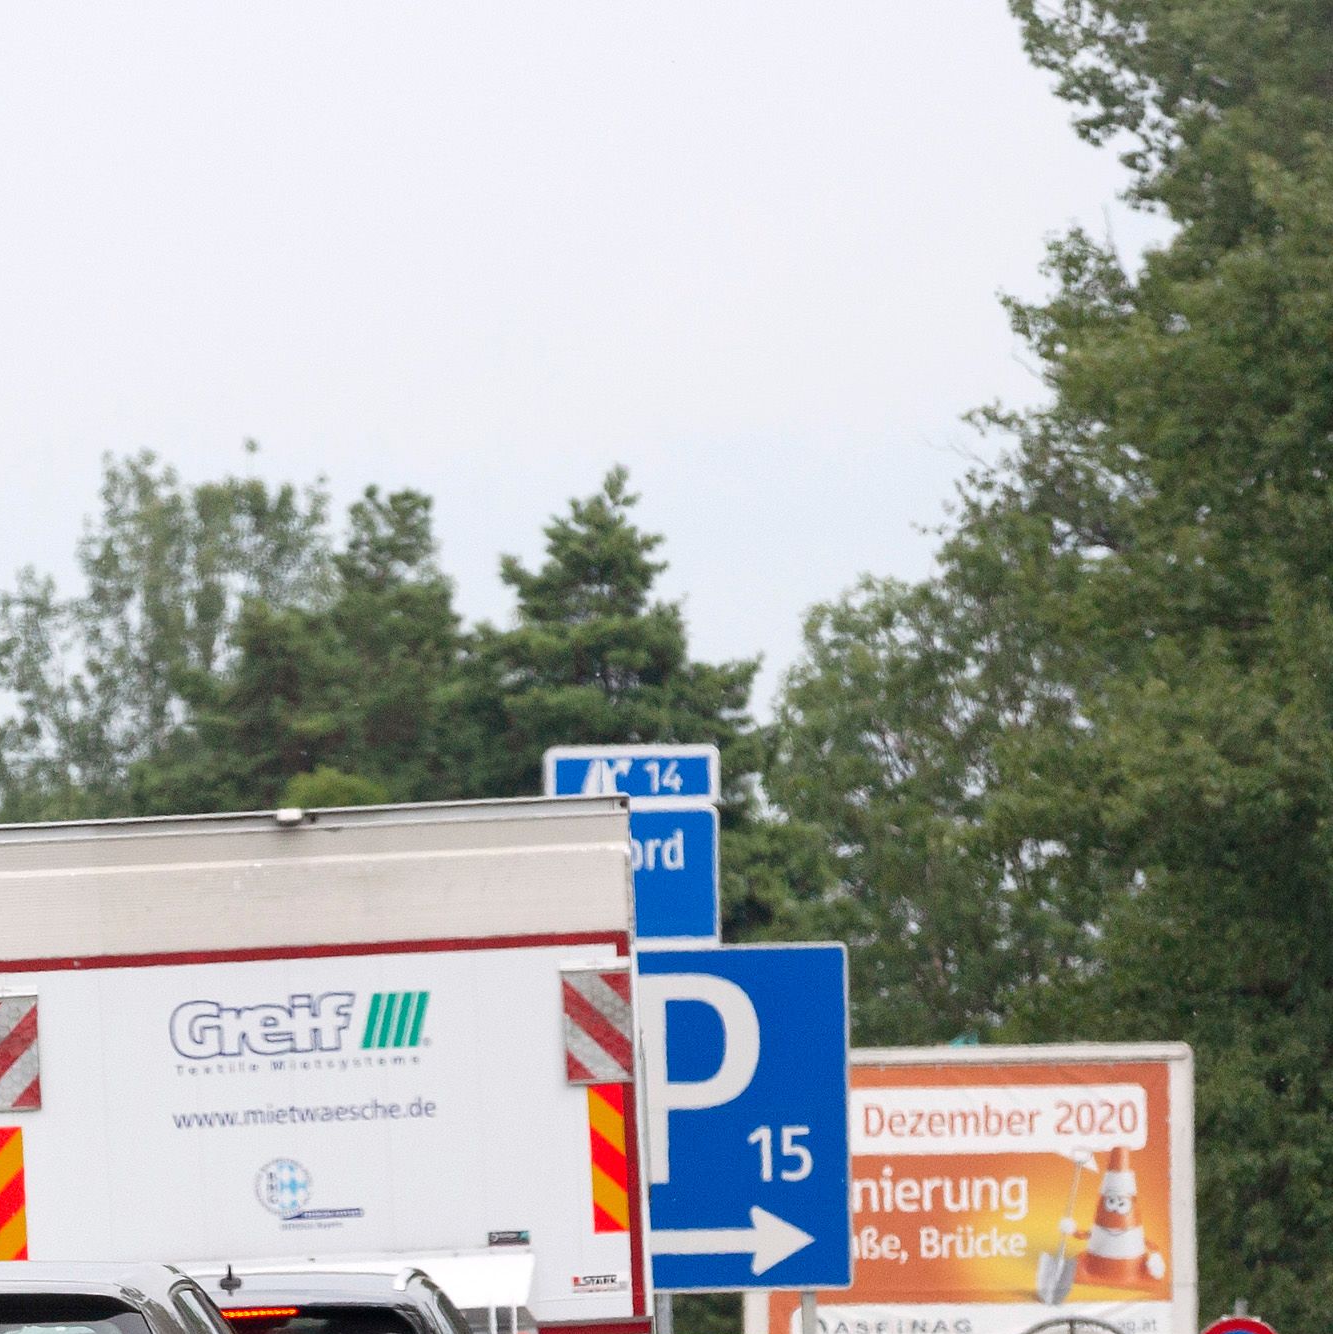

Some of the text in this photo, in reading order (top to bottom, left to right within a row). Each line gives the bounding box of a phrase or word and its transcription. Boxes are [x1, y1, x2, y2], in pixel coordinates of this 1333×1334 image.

[642, 760, 683, 794] 14
[631, 828, 685, 871] ord
[169, 991, 355, 1060] Greif
[639, 972, 760, 1184] P
[172, 1096, 437, 1130] www.mietwaesche.de
[863, 1100, 1138, 1138] Dezember 2020
[747, 1125, 814, 1182] 15
[852, 1165, 1029, 1221] nierung
[851, 1225, 1028, 1264] ße, Brücke
